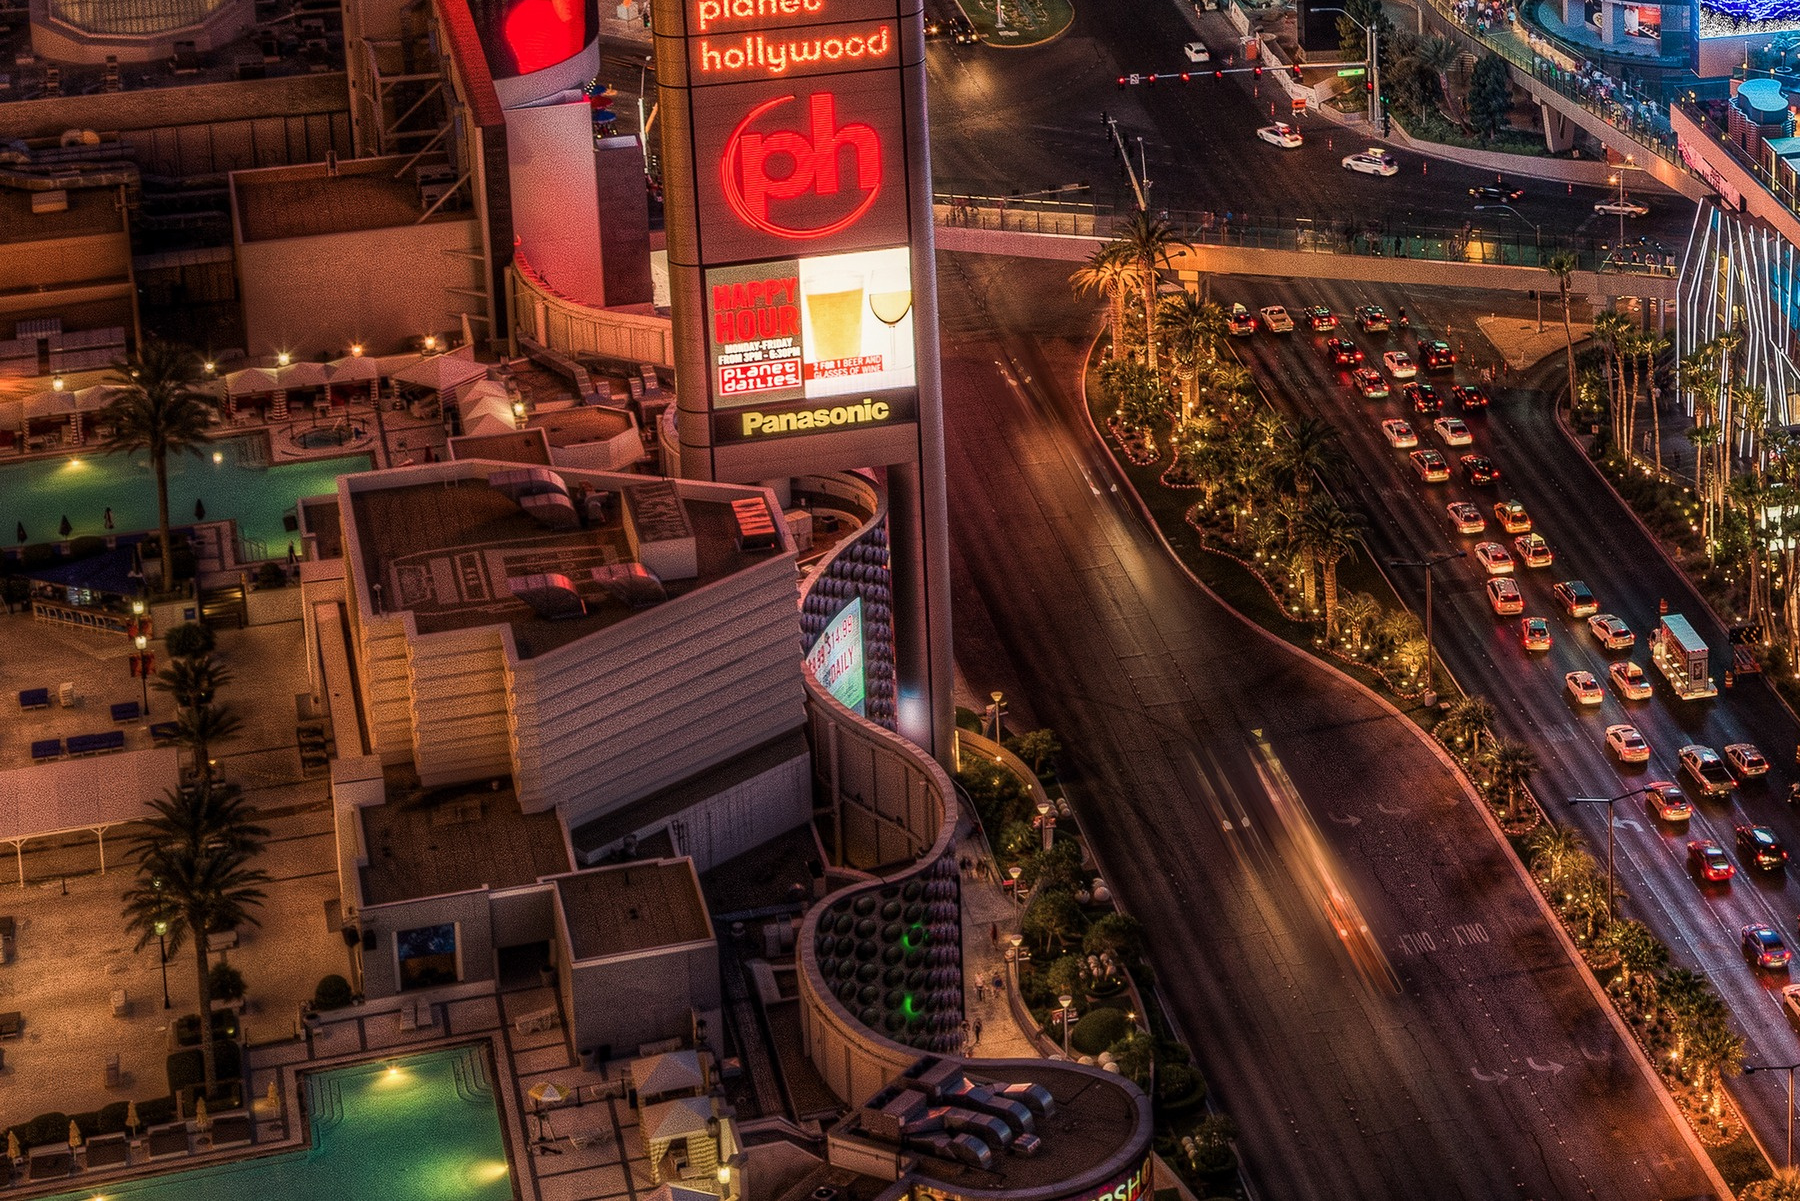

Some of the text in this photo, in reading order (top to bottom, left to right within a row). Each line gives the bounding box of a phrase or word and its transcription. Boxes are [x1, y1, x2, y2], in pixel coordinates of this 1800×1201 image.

[700, 26, 889, 73] hollywood
[739, 92, 882, 220] ph
[712, 276, 798, 311] HAPPY
[714, 304, 801, 344] HOUR
[718, 354, 743, 365] FROM
[743, 351, 763, 363] 3PM
[724, 337, 794, 354] MONDAY-FRIDAY
[843, 357, 863, 367] BEER
[741, 398, 889, 436] Panasonic
